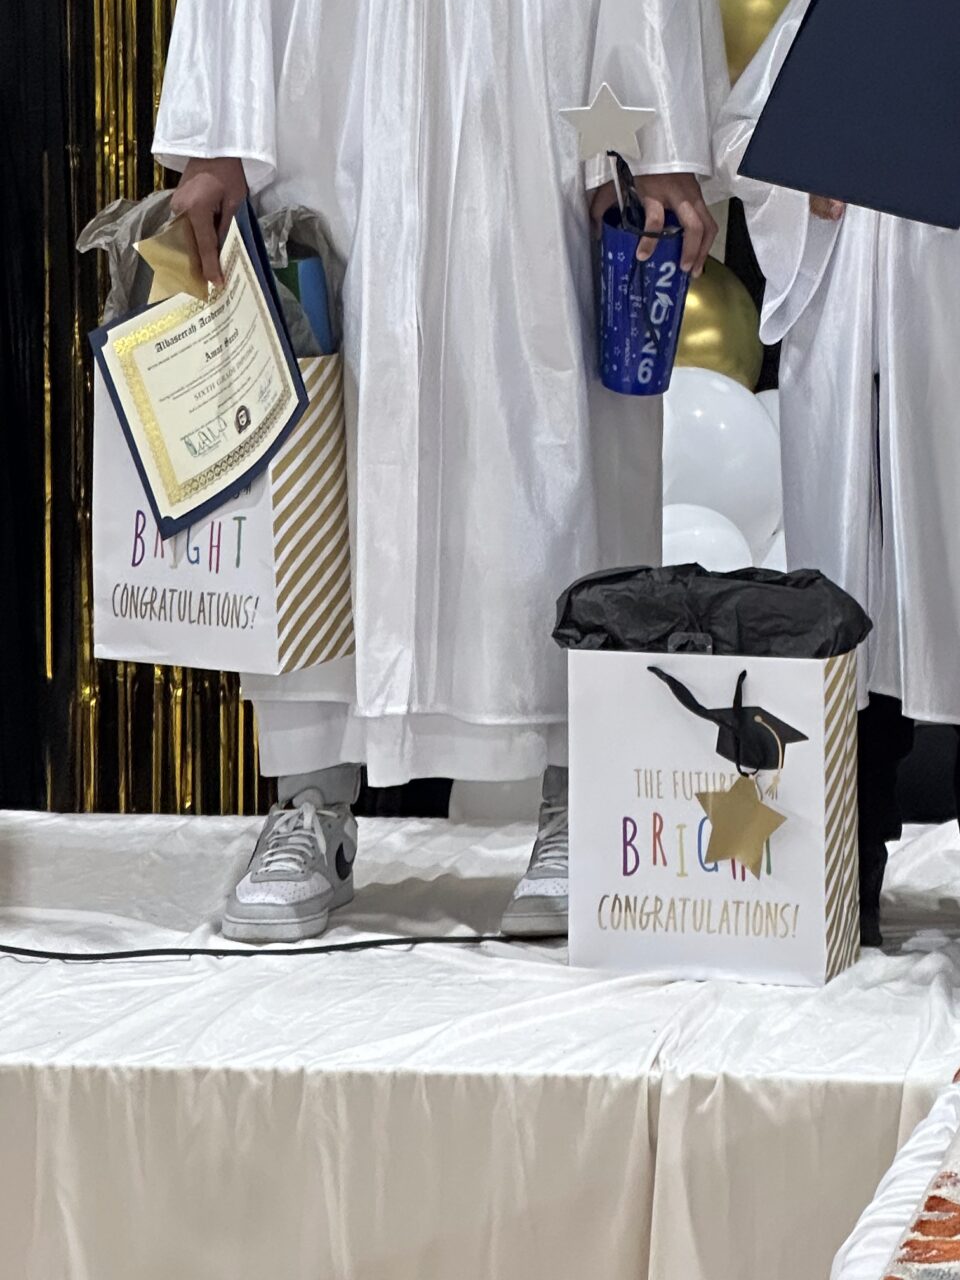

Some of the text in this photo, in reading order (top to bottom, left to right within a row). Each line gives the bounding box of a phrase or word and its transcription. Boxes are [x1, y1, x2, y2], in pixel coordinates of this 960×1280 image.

[112, 582, 260, 630] CONGRATULATIONS!
[634, 768, 664, 799] THE
[622, 812, 772, 882] BRIG
[598, 893, 800, 939] CONGRATULATIONS!
